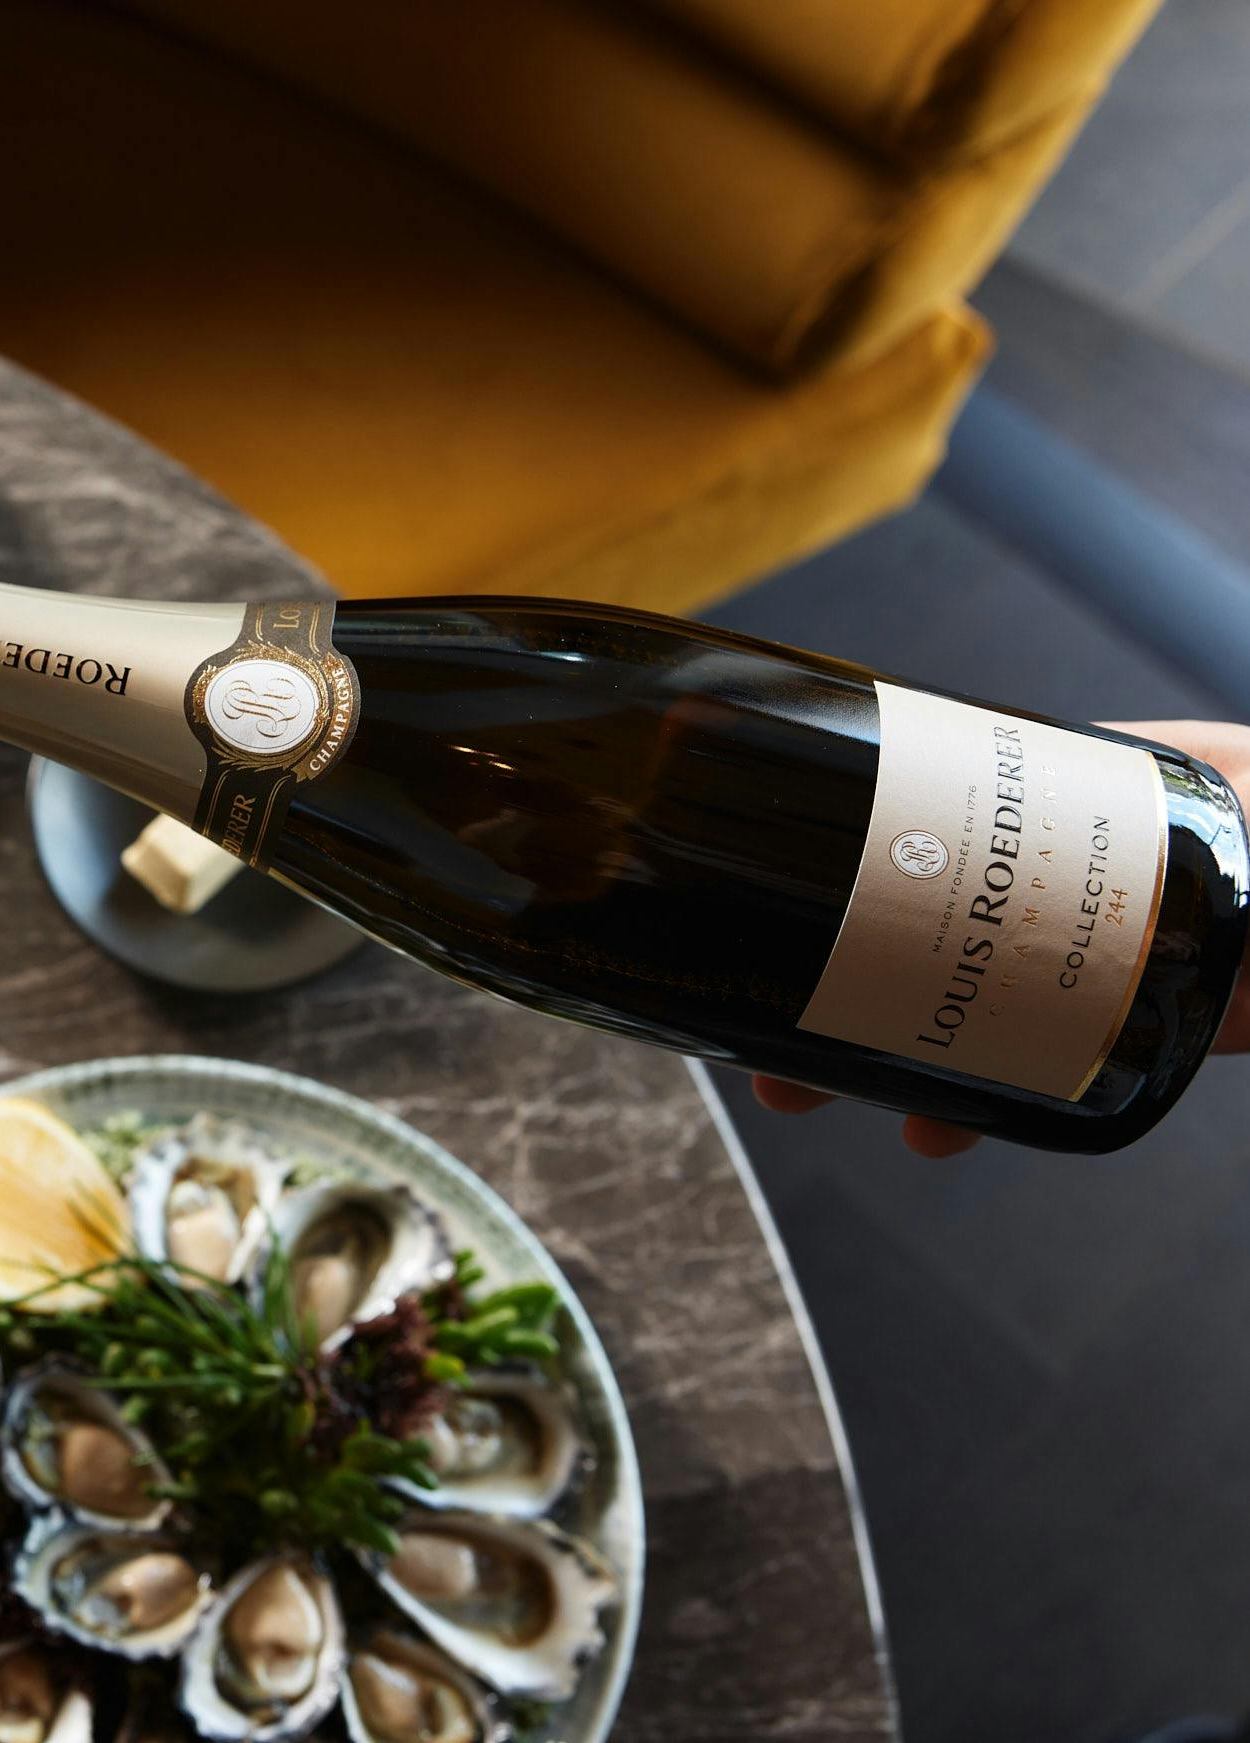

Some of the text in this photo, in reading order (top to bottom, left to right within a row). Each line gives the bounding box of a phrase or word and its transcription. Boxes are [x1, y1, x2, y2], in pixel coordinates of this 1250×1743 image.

[308, 667, 352, 772] CHAMPAGNE
[916, 726, 1024, 1049] LOUIS ROEDERER
[932, 785, 977, 953] MAISON FONDÉE EN 1776
[989, 765, 1058, 1017] CHAMPAGNE
[1059, 815, 1110, 989] COLLECTION
[1105, 888, 1128, 927] 244
